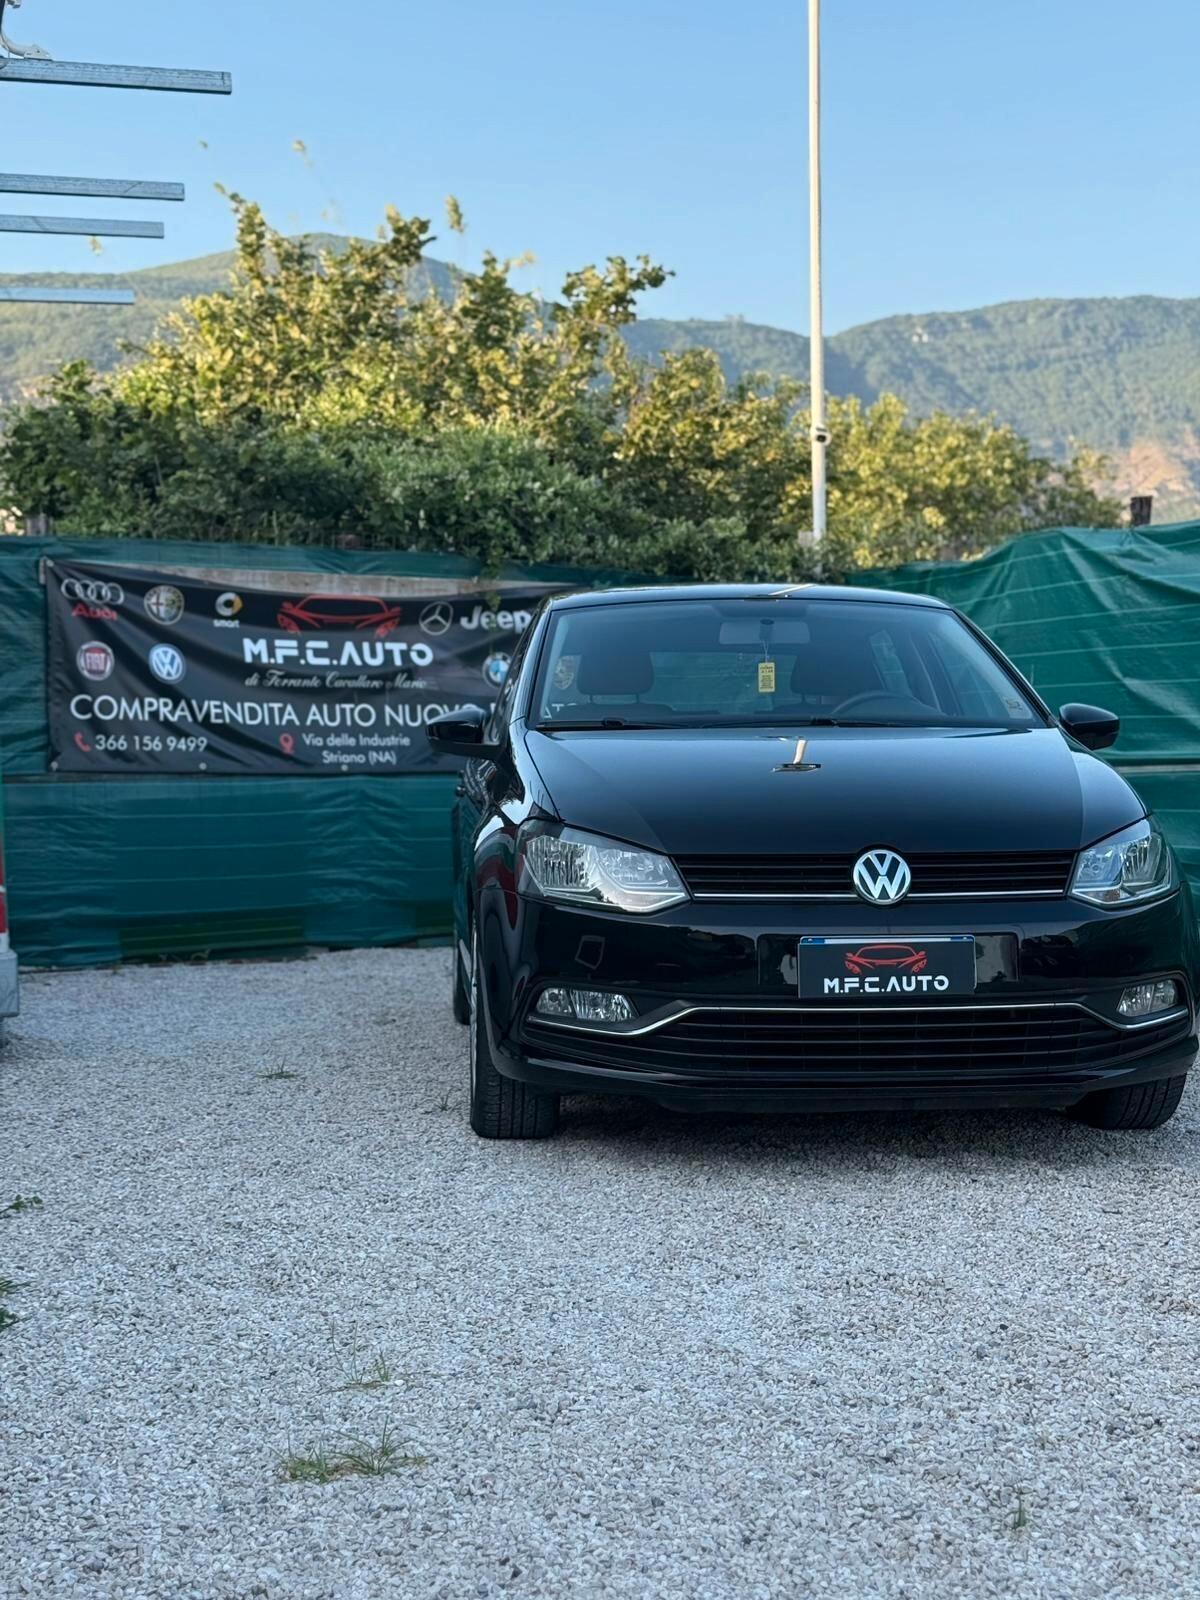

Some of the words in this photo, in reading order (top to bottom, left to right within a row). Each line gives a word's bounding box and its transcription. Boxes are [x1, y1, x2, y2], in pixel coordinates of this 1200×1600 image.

[72, 603, 117, 621] Audi
[460, 606, 532, 634] Jeep
[213, 619, 240, 629] smart
[243, 638, 434, 667] M.F.C.AUTO
[244, 672, 260, 687] di
[70, 694, 300, 726] COMPRAVENDITA
[306, 703, 377, 727] AUTO
[385, 703, 478, 728] NUO
[95, 735, 128, 751] 366
[134, 736, 163, 751] 156
[166, 737, 208, 751] 9499
[302, 733, 324, 747] Via
[326, 733, 356, 747] delle
[359, 733, 411, 747] Industrie
[322, 751, 366, 764] Striano
[369, 751, 397, 765] (NA)
[823, 975, 950, 994] M.F.C.AUTO
